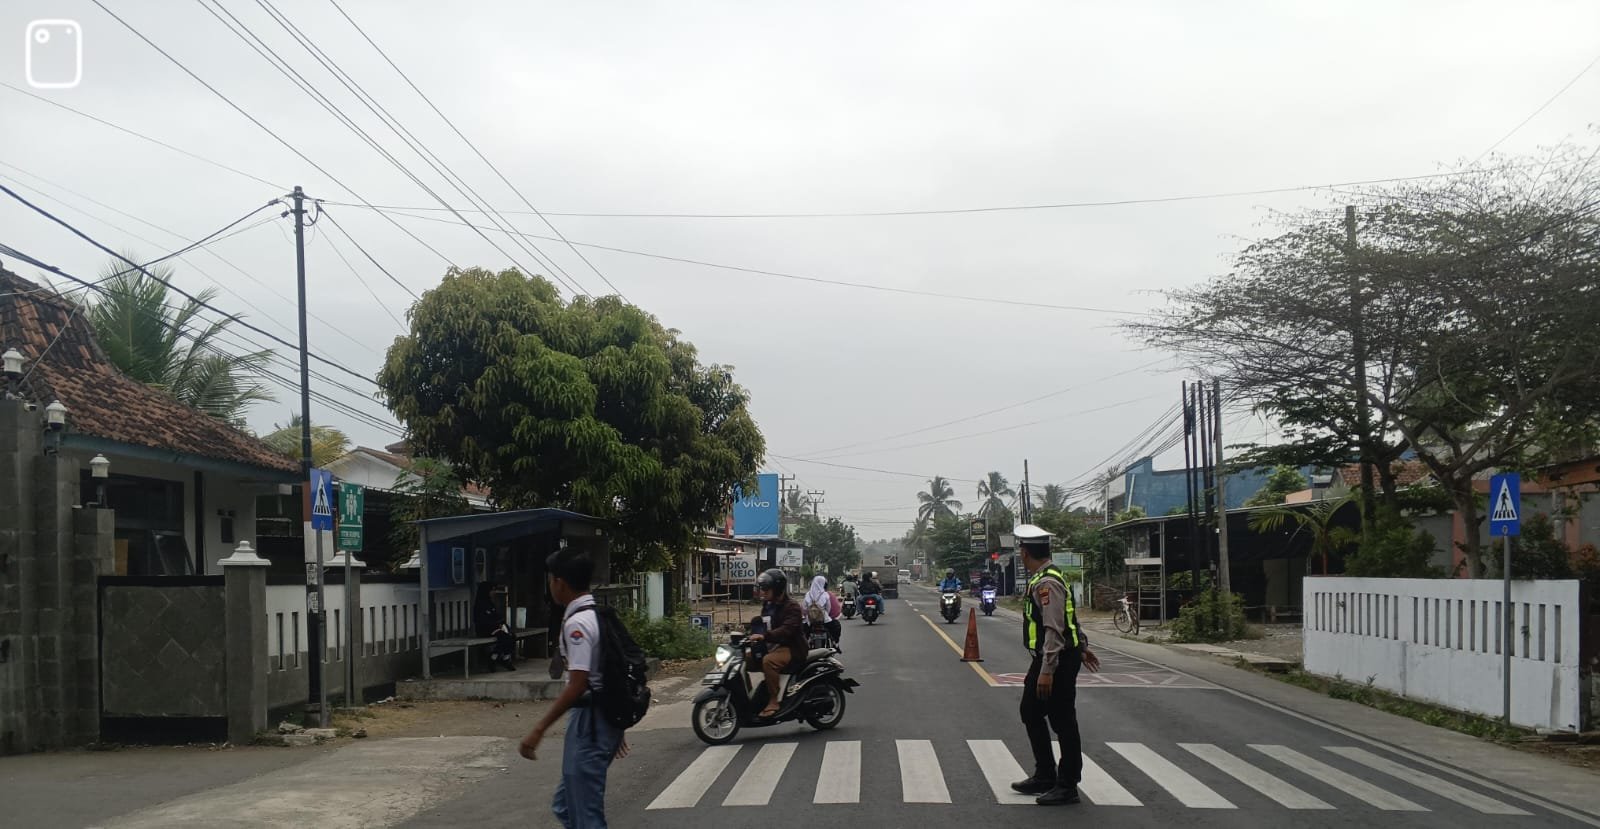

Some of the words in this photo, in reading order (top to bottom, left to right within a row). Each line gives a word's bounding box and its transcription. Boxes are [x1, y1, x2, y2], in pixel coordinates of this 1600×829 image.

[742, 499, 770, 508] vivo
[720, 561, 749, 570] TOKO
[730, 569, 755, 578] KEJO
